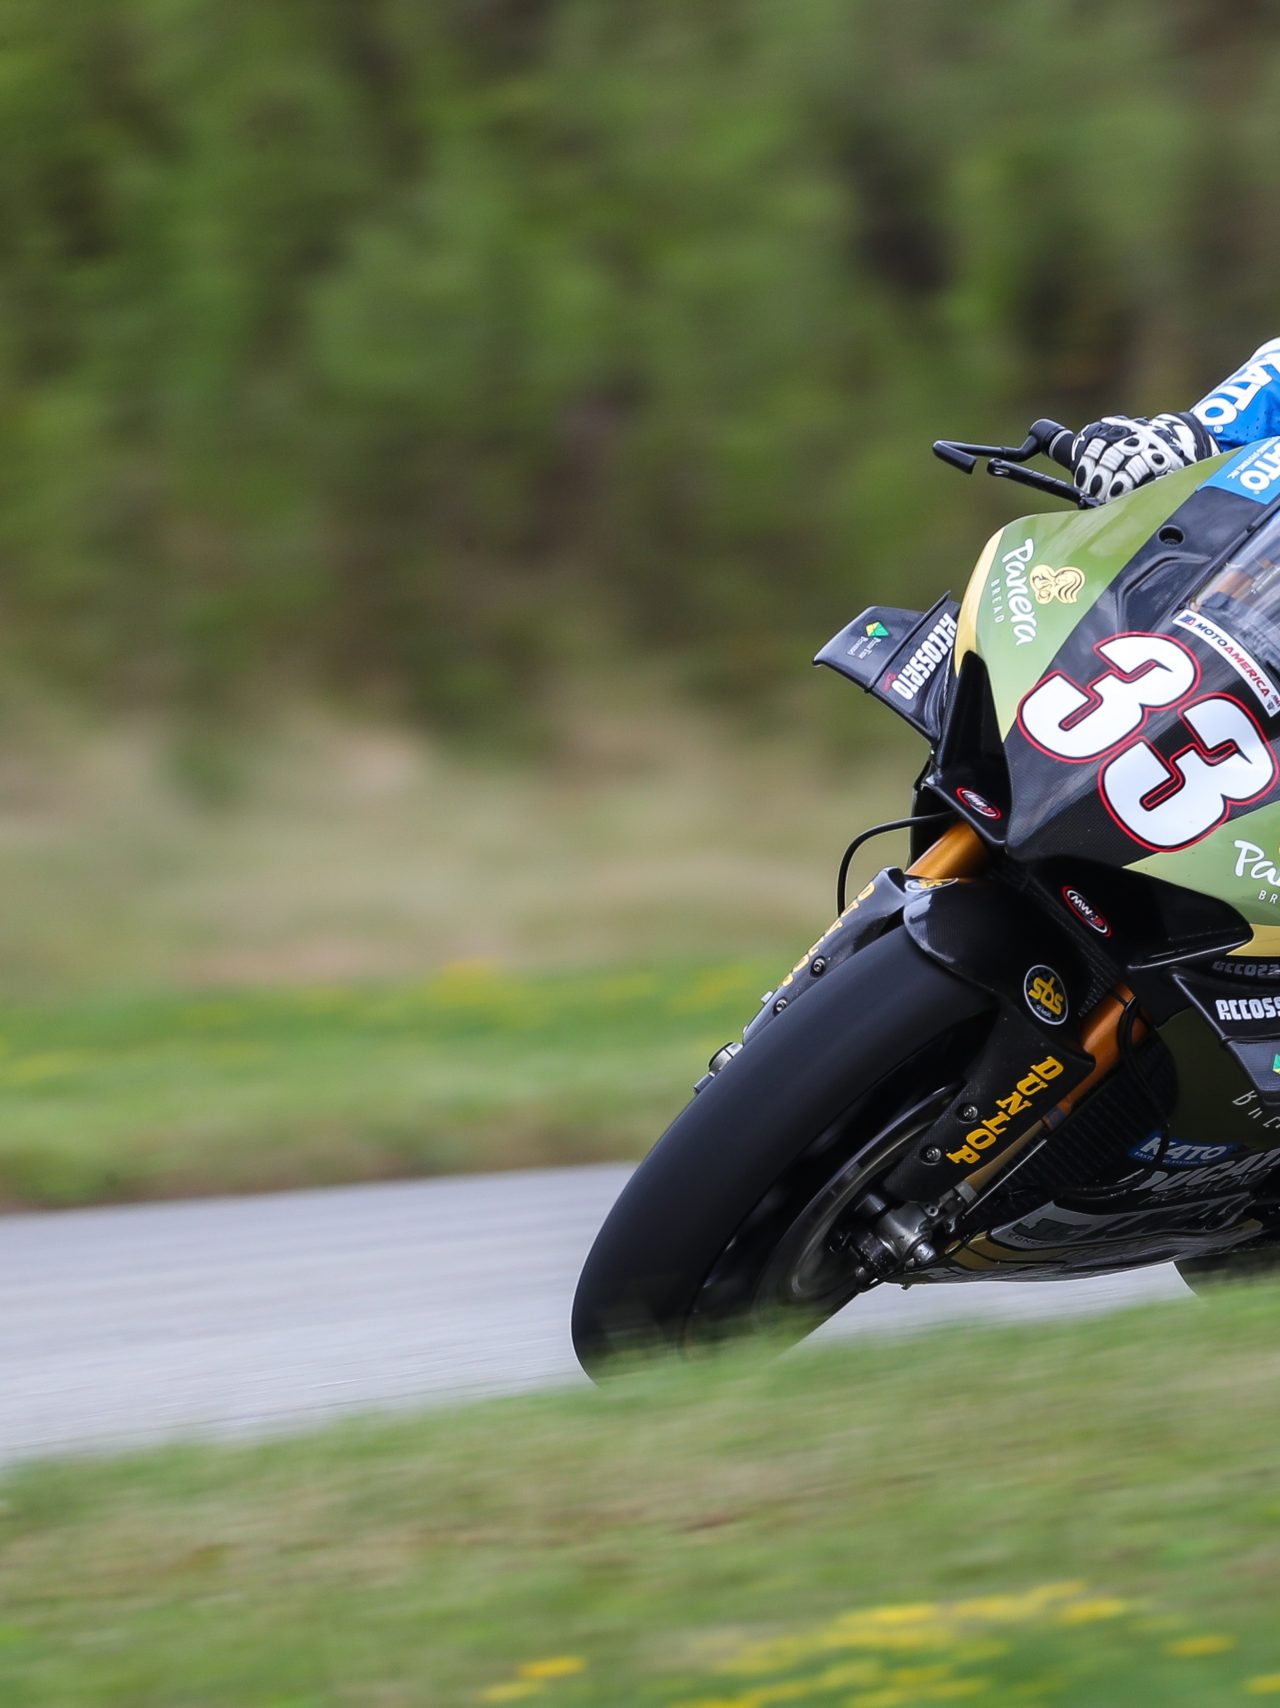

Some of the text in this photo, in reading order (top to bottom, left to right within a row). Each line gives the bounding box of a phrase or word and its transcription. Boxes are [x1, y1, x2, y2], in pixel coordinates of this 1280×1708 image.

[990, 578, 1005, 624] BREAD
[1002, 537, 1037, 646] Panera
[1195, 621, 1270, 698] MOTOAMERICA
[1017, 631, 1280, 853] 33
[1027, 976, 1064, 1016] sbs
[946, 1055, 1064, 1164] DUNLOP
[1139, 1136, 1229, 1160] KATO
